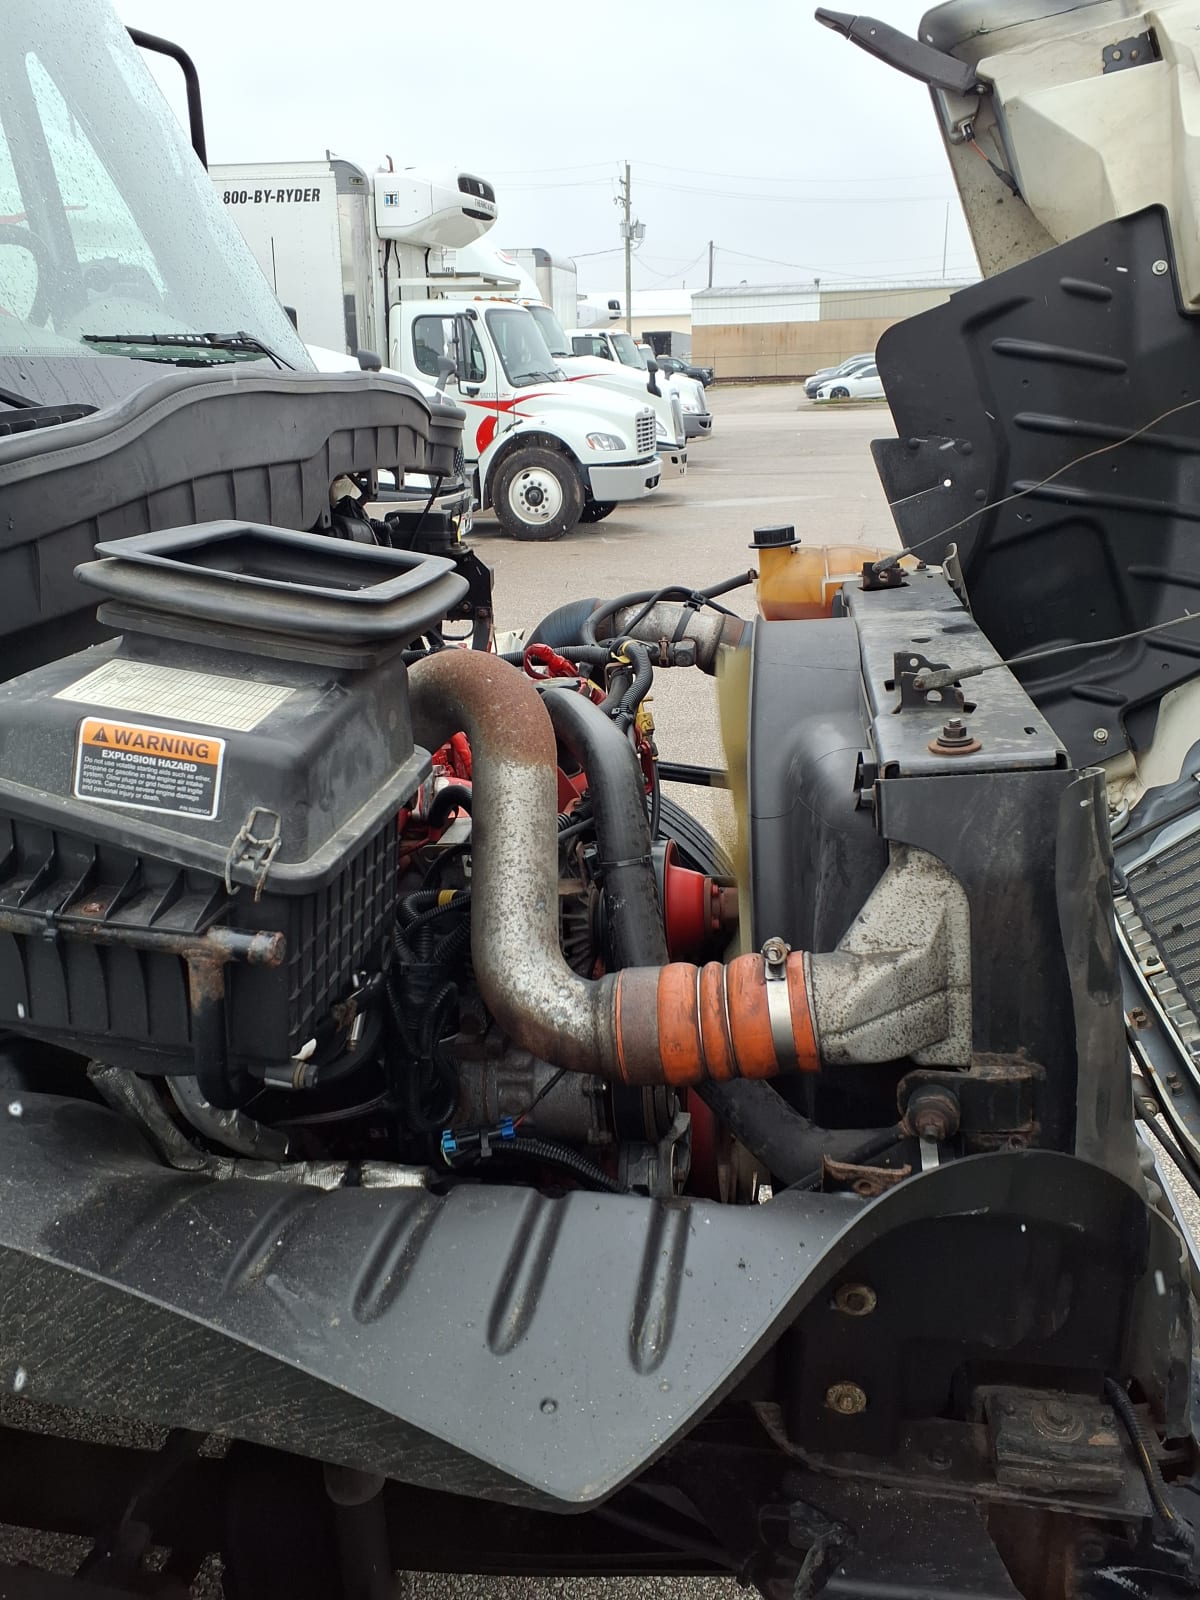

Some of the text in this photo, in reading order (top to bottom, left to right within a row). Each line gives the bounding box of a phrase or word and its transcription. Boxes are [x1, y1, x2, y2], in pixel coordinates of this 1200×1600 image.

[114, 729, 209, 759] WARNING
[102, 749, 197, 772] EXPLOSION HAZARD
[83, 763, 107, 773] propane
[115, 768, 139, 778] gasoline
[157, 775, 176, 784] engine
[186, 780, 204, 788] intake
[137, 765, 158, 775] starting
[172, 770, 186, 778] such
[105, 773, 120, 781] Glow
[145, 780, 157, 788] grid
[157, 781, 176, 790] heater
[93, 786, 118, 795] personal
[118, 789, 134, 798] injury
[135, 786, 155, 794] severe
[155, 789, 175, 797] engine
[176, 792, 199, 801] damage
